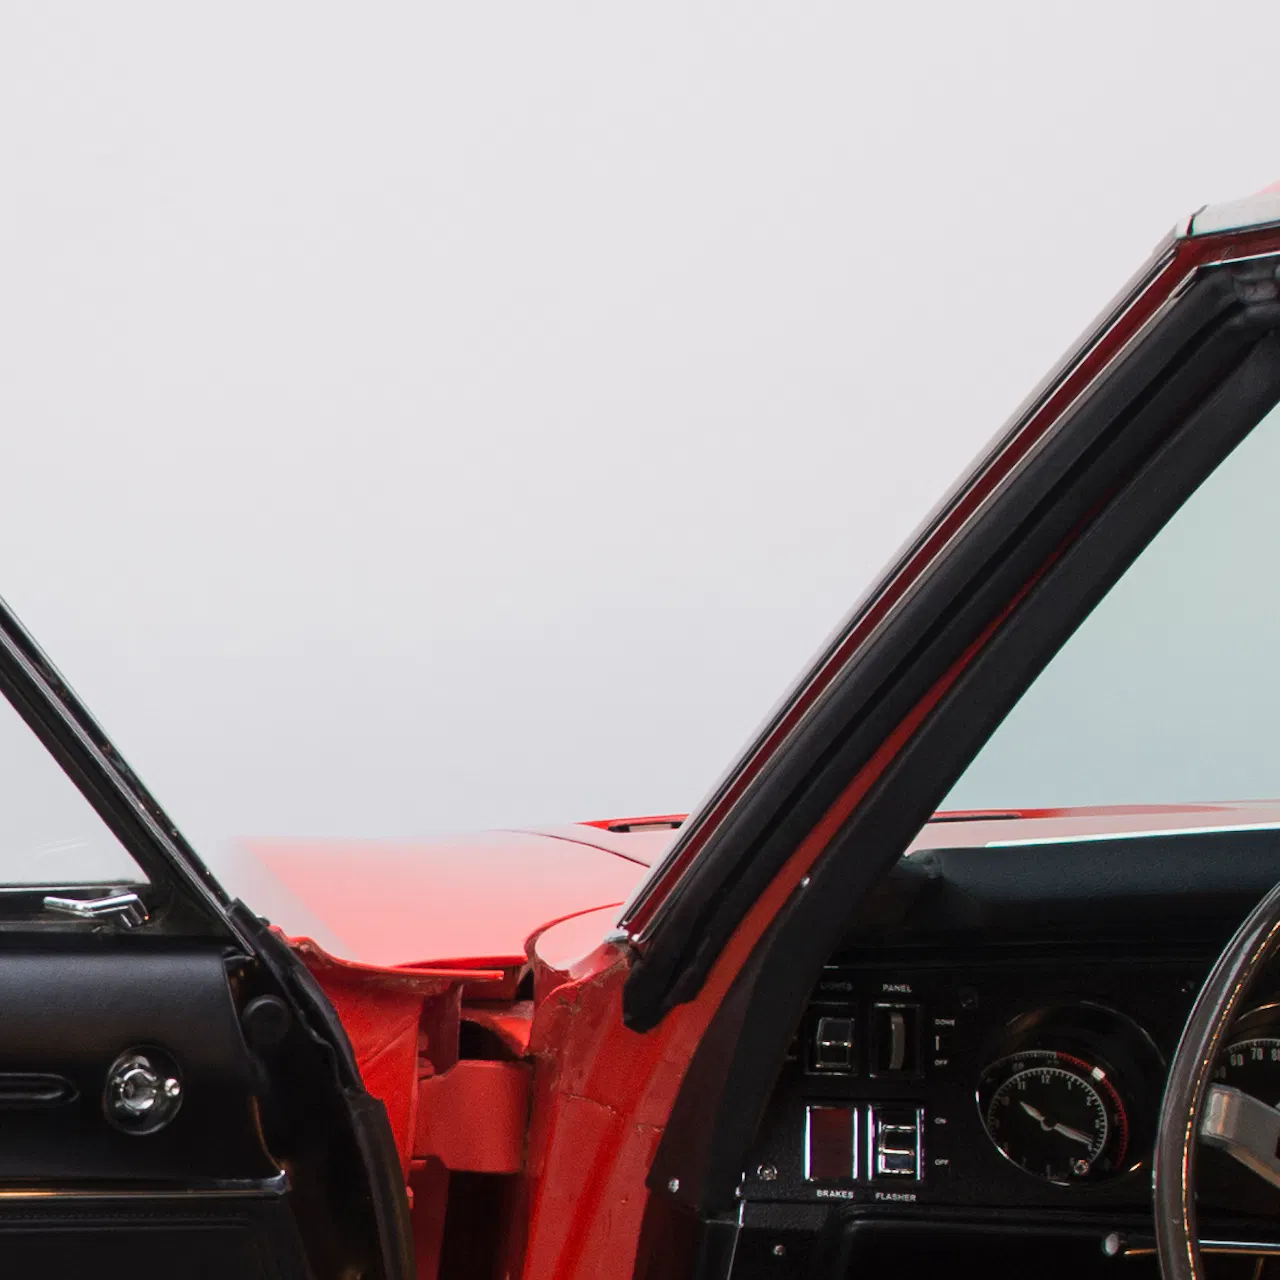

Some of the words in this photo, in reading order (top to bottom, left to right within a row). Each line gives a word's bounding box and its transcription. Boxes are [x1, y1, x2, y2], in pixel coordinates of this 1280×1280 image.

[882, 983, 913, 993] PANEL
[1251, 1047, 1264, 1060] 70
[816, 1189, 855, 1199] BRAKES
[875, 1192, 917, 1202] FLASHER
